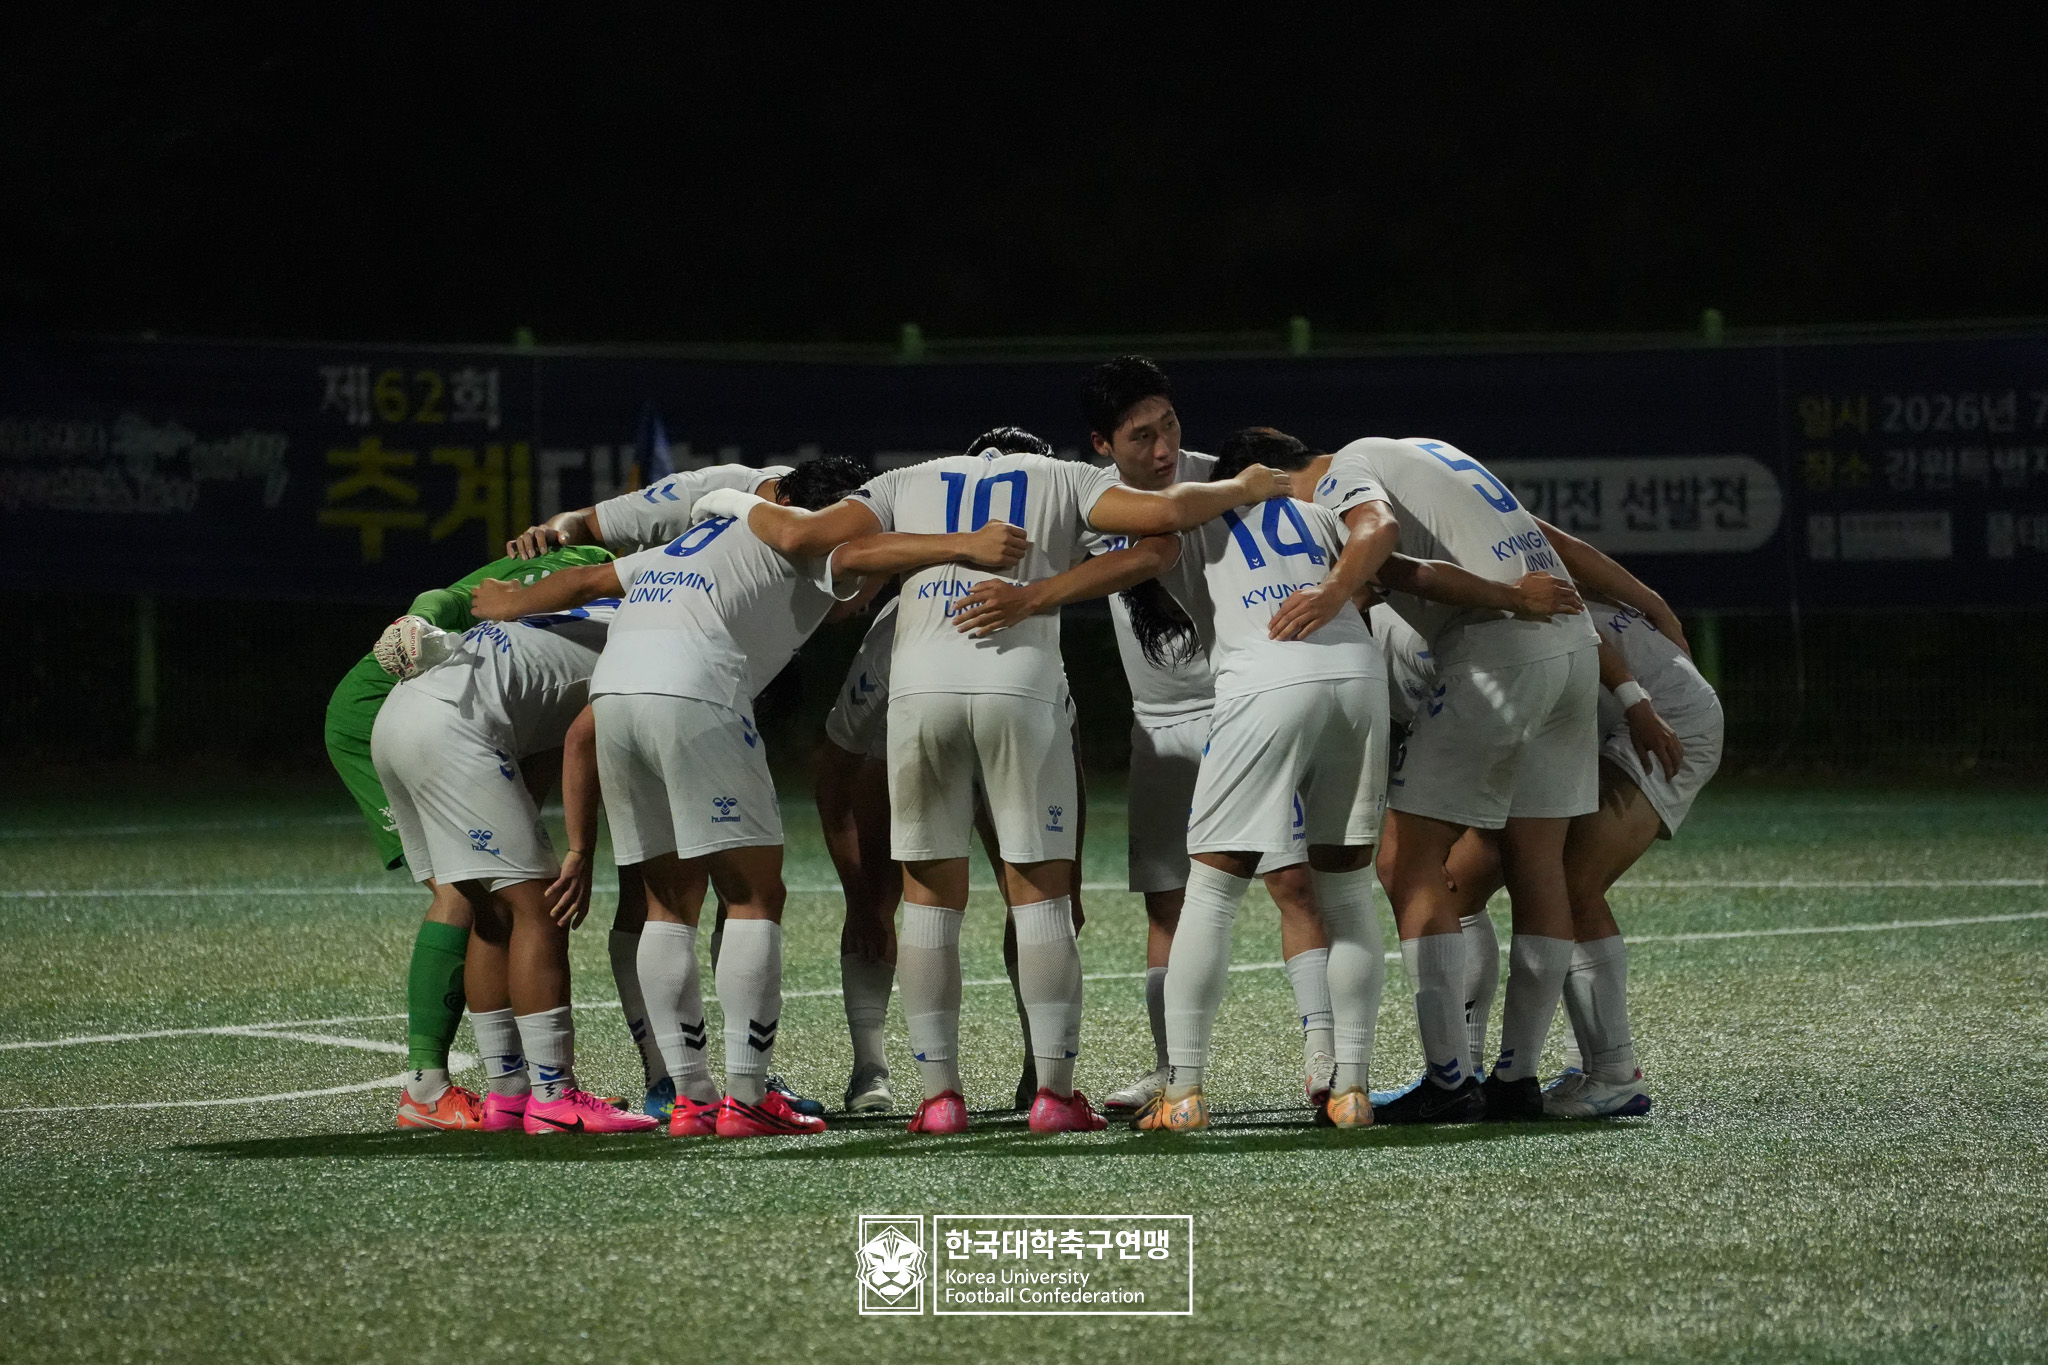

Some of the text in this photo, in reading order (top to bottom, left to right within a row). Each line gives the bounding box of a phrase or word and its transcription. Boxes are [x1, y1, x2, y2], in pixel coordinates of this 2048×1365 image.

[319, 365, 500, 429] 제62회
[1880, 390, 2017, 433] 2026년
[940, 469, 1028, 534] 10
[1416, 443, 1518, 513] 5
[1502, 472, 1748, 532] 기전 선발전
[1222, 496, 1327, 570] 14
[629, 587, 673, 603] UNIV.
[711, 815, 741, 823] hummel
